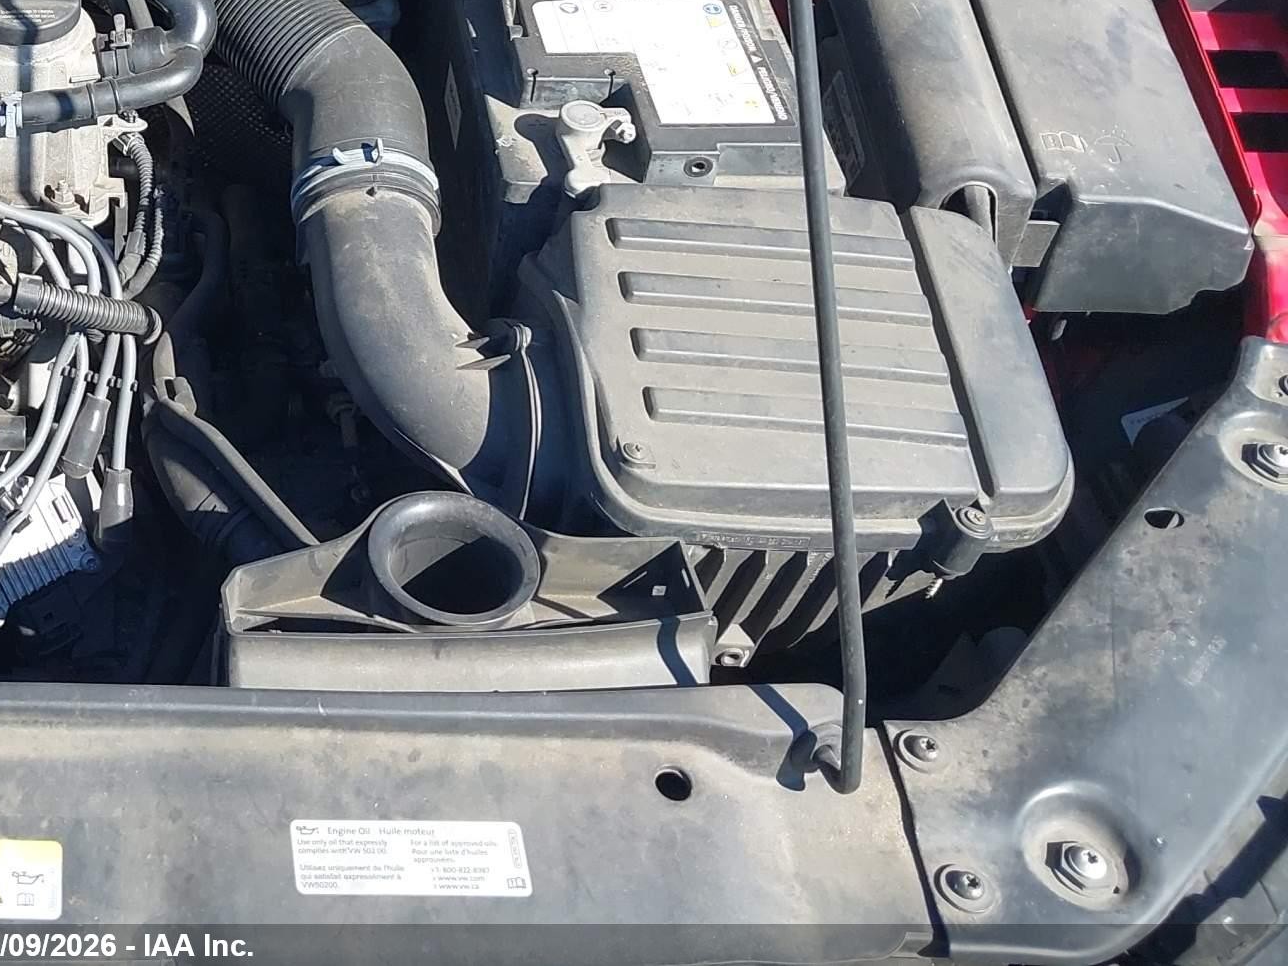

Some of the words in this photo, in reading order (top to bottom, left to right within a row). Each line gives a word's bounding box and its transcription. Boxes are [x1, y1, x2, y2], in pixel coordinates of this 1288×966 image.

[328, 827, 356, 837] Engine
[358, 827, 371, 835] Oil
[379, 827, 401, 835] Huile
[404, 828, 435, 836] moteur
